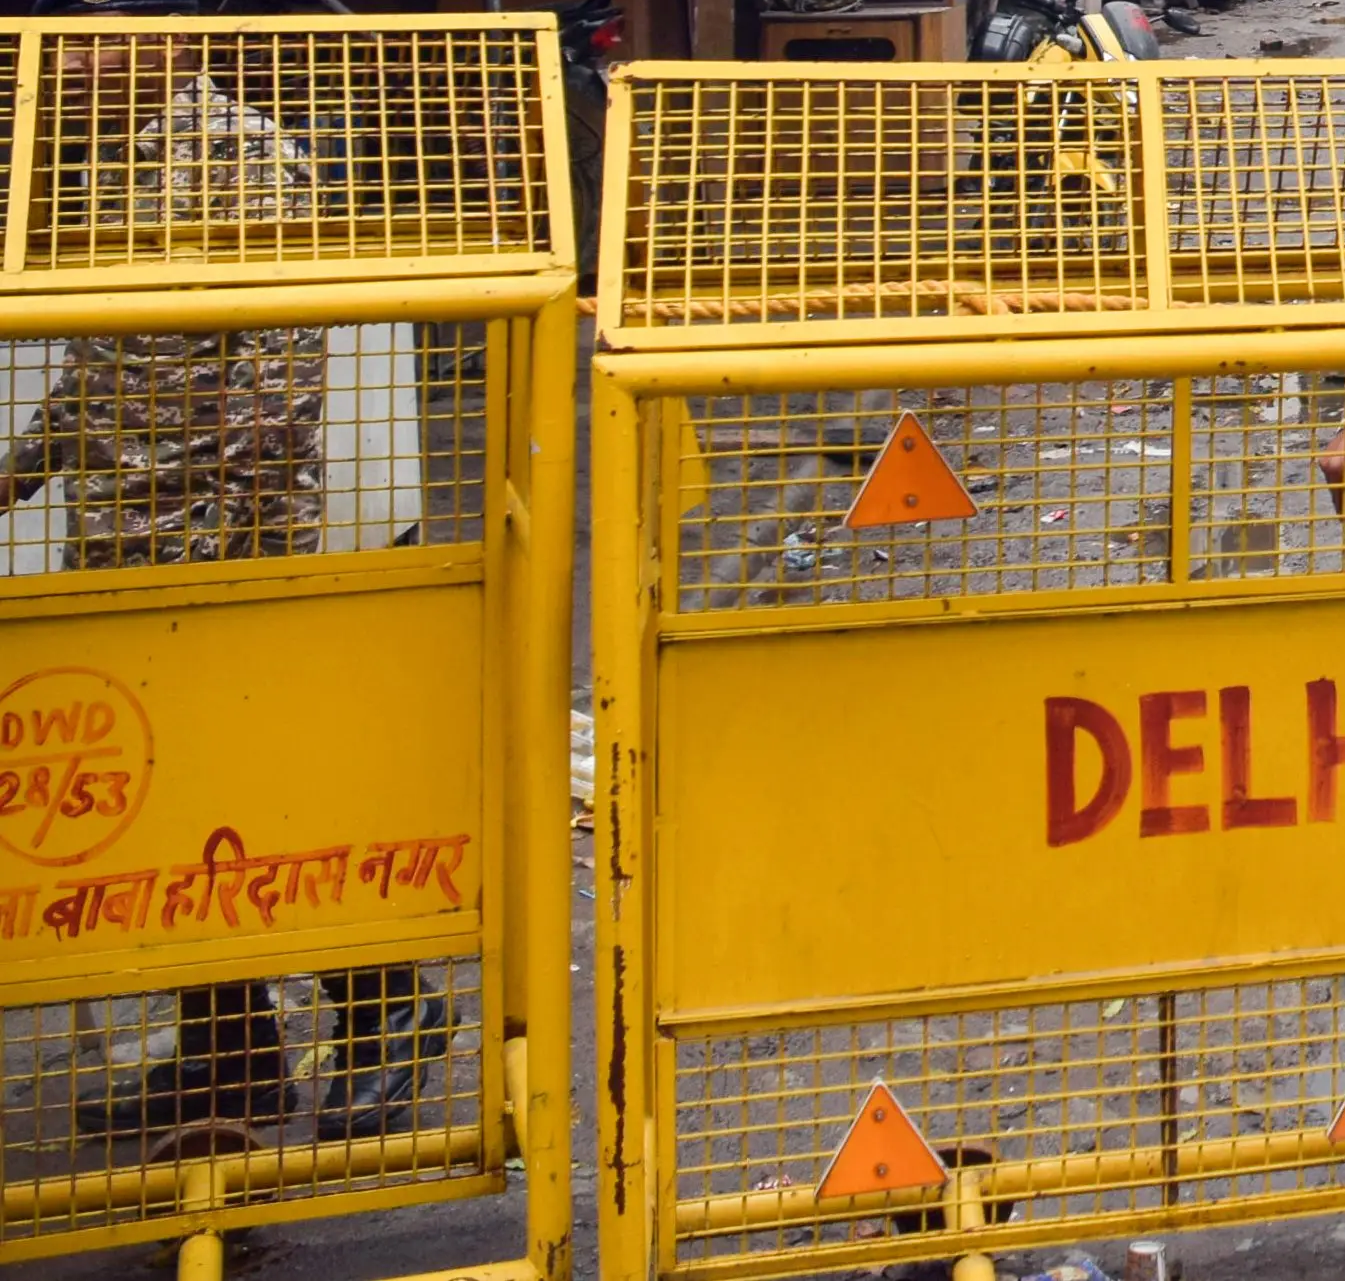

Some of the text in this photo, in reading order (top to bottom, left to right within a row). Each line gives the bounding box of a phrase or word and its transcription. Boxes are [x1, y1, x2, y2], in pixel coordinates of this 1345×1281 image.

[2, 701, 116, 749] DWD
[0, 756, 131, 849] 28/53
[43, 869, 160, 940] बाबा
[162, 826, 352, 929] हरिदास
[359, 834, 472, 904] नगर
